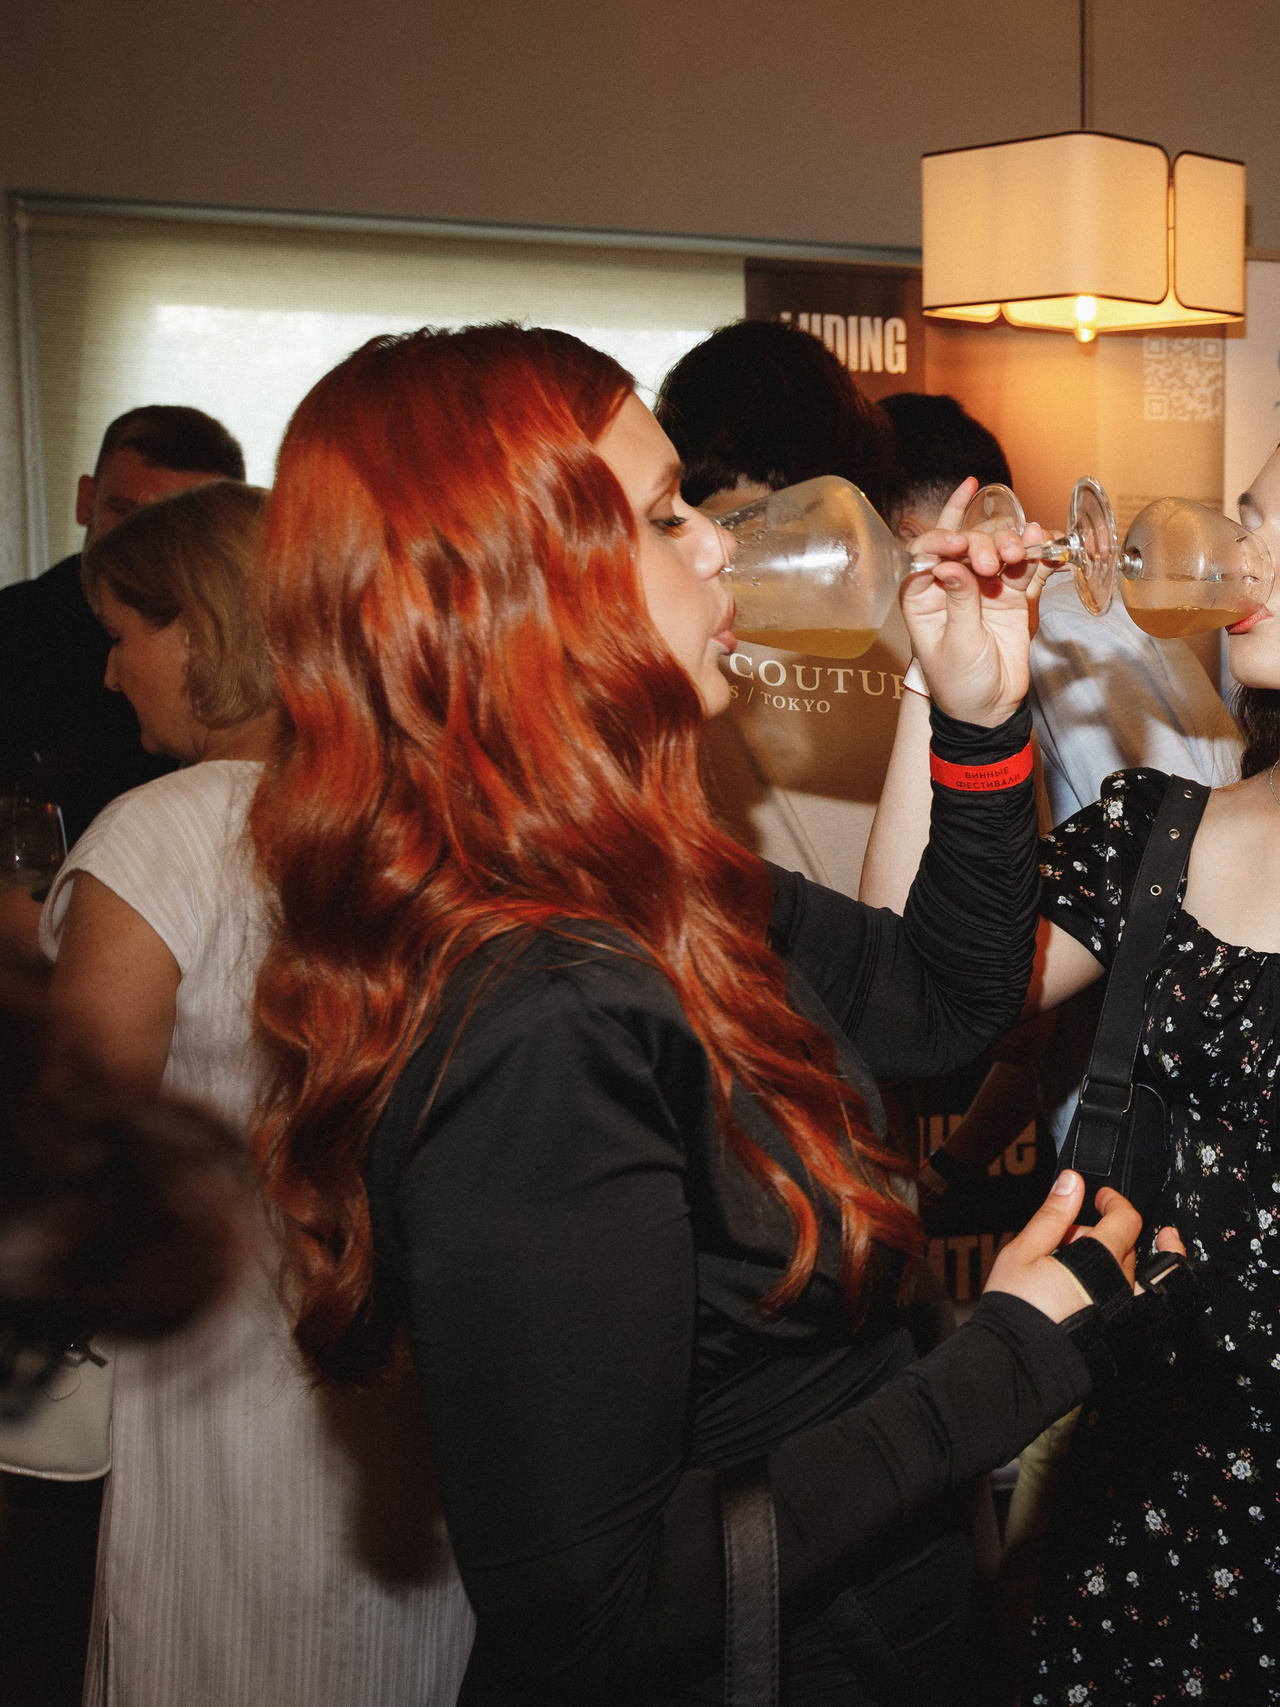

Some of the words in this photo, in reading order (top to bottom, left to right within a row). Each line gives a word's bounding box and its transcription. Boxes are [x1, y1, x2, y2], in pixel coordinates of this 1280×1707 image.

[780, 311, 907, 374] DING
[729, 652, 906, 701] COUTUR
[761, 690, 831, 714] TOKYO
[955, 773, 1021, 790] ФЕСТИВАЛИ
[965, 766, 1009, 780] ВИННЫЕ
